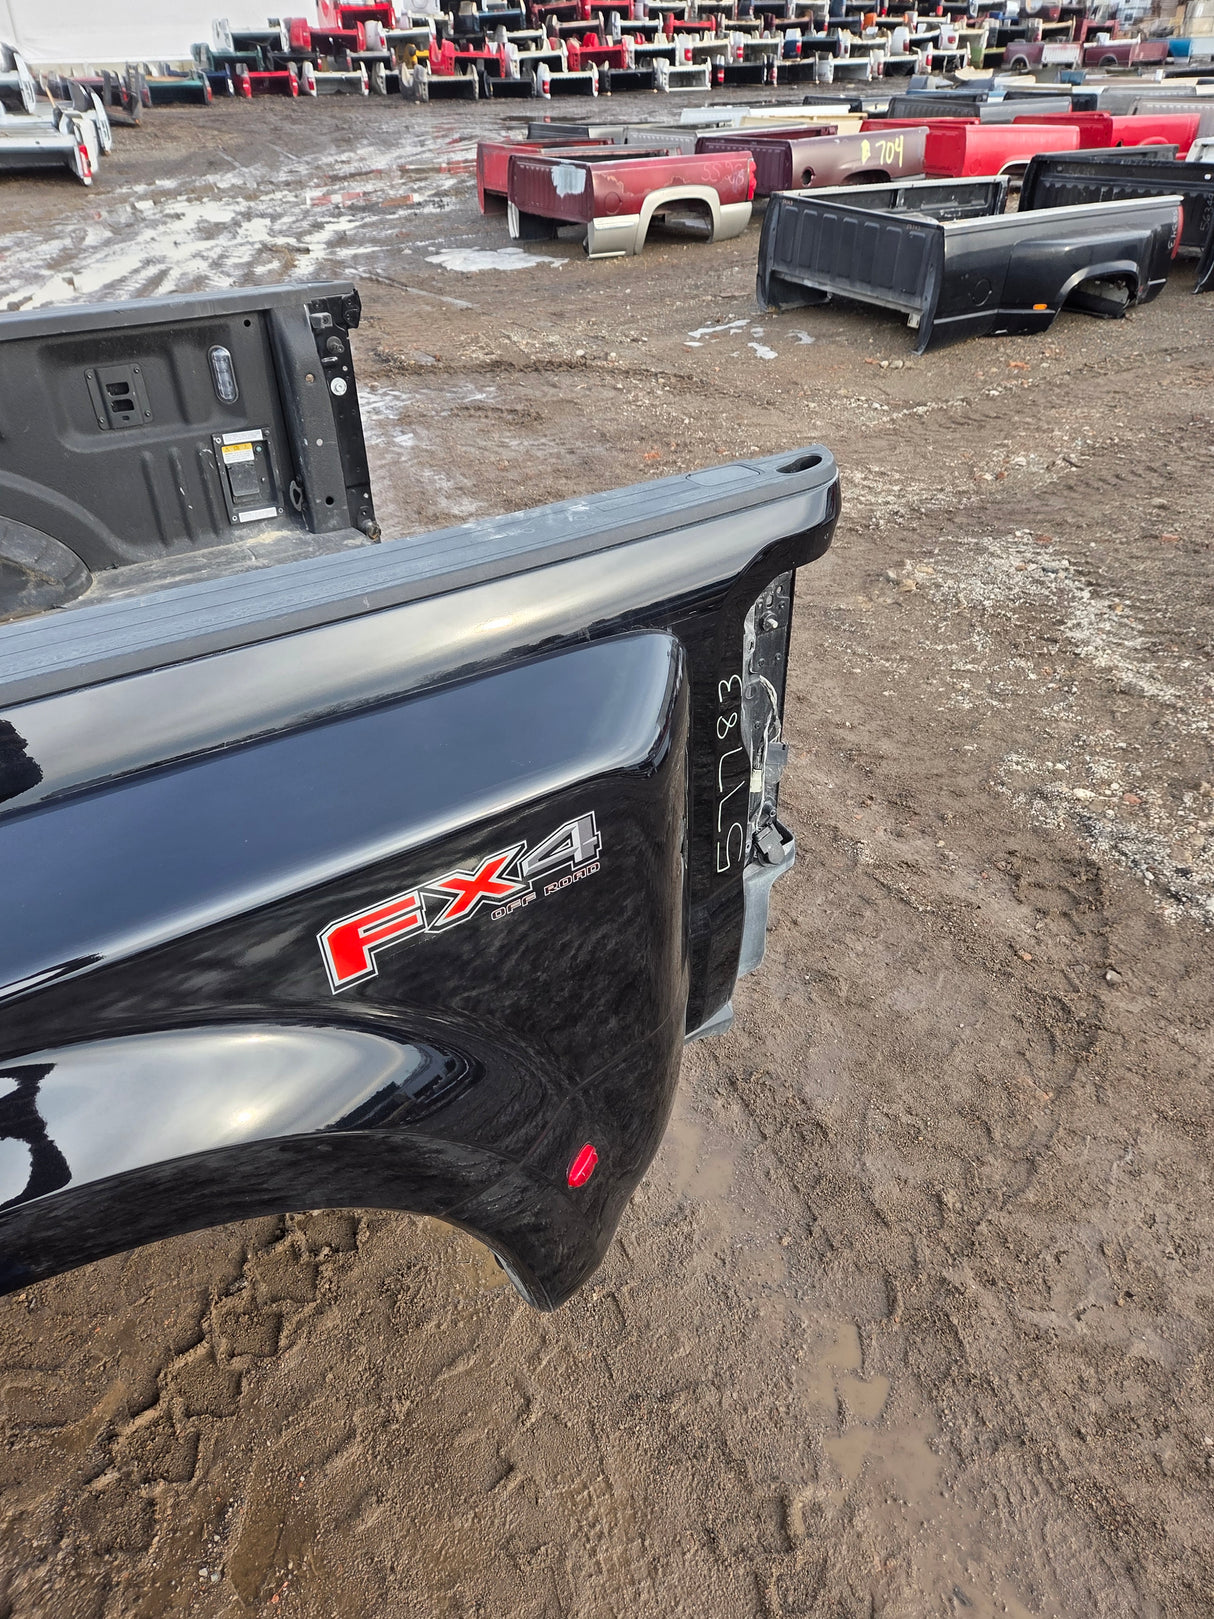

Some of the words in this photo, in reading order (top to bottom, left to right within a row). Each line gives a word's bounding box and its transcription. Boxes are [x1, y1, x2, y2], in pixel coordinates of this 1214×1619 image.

[875, 134, 904, 168] 704
[716, 674, 746, 873] 57783
[316, 810, 602, 995] FX4
[490, 893, 537, 921] OFF
[543, 861, 601, 897] ROAD
